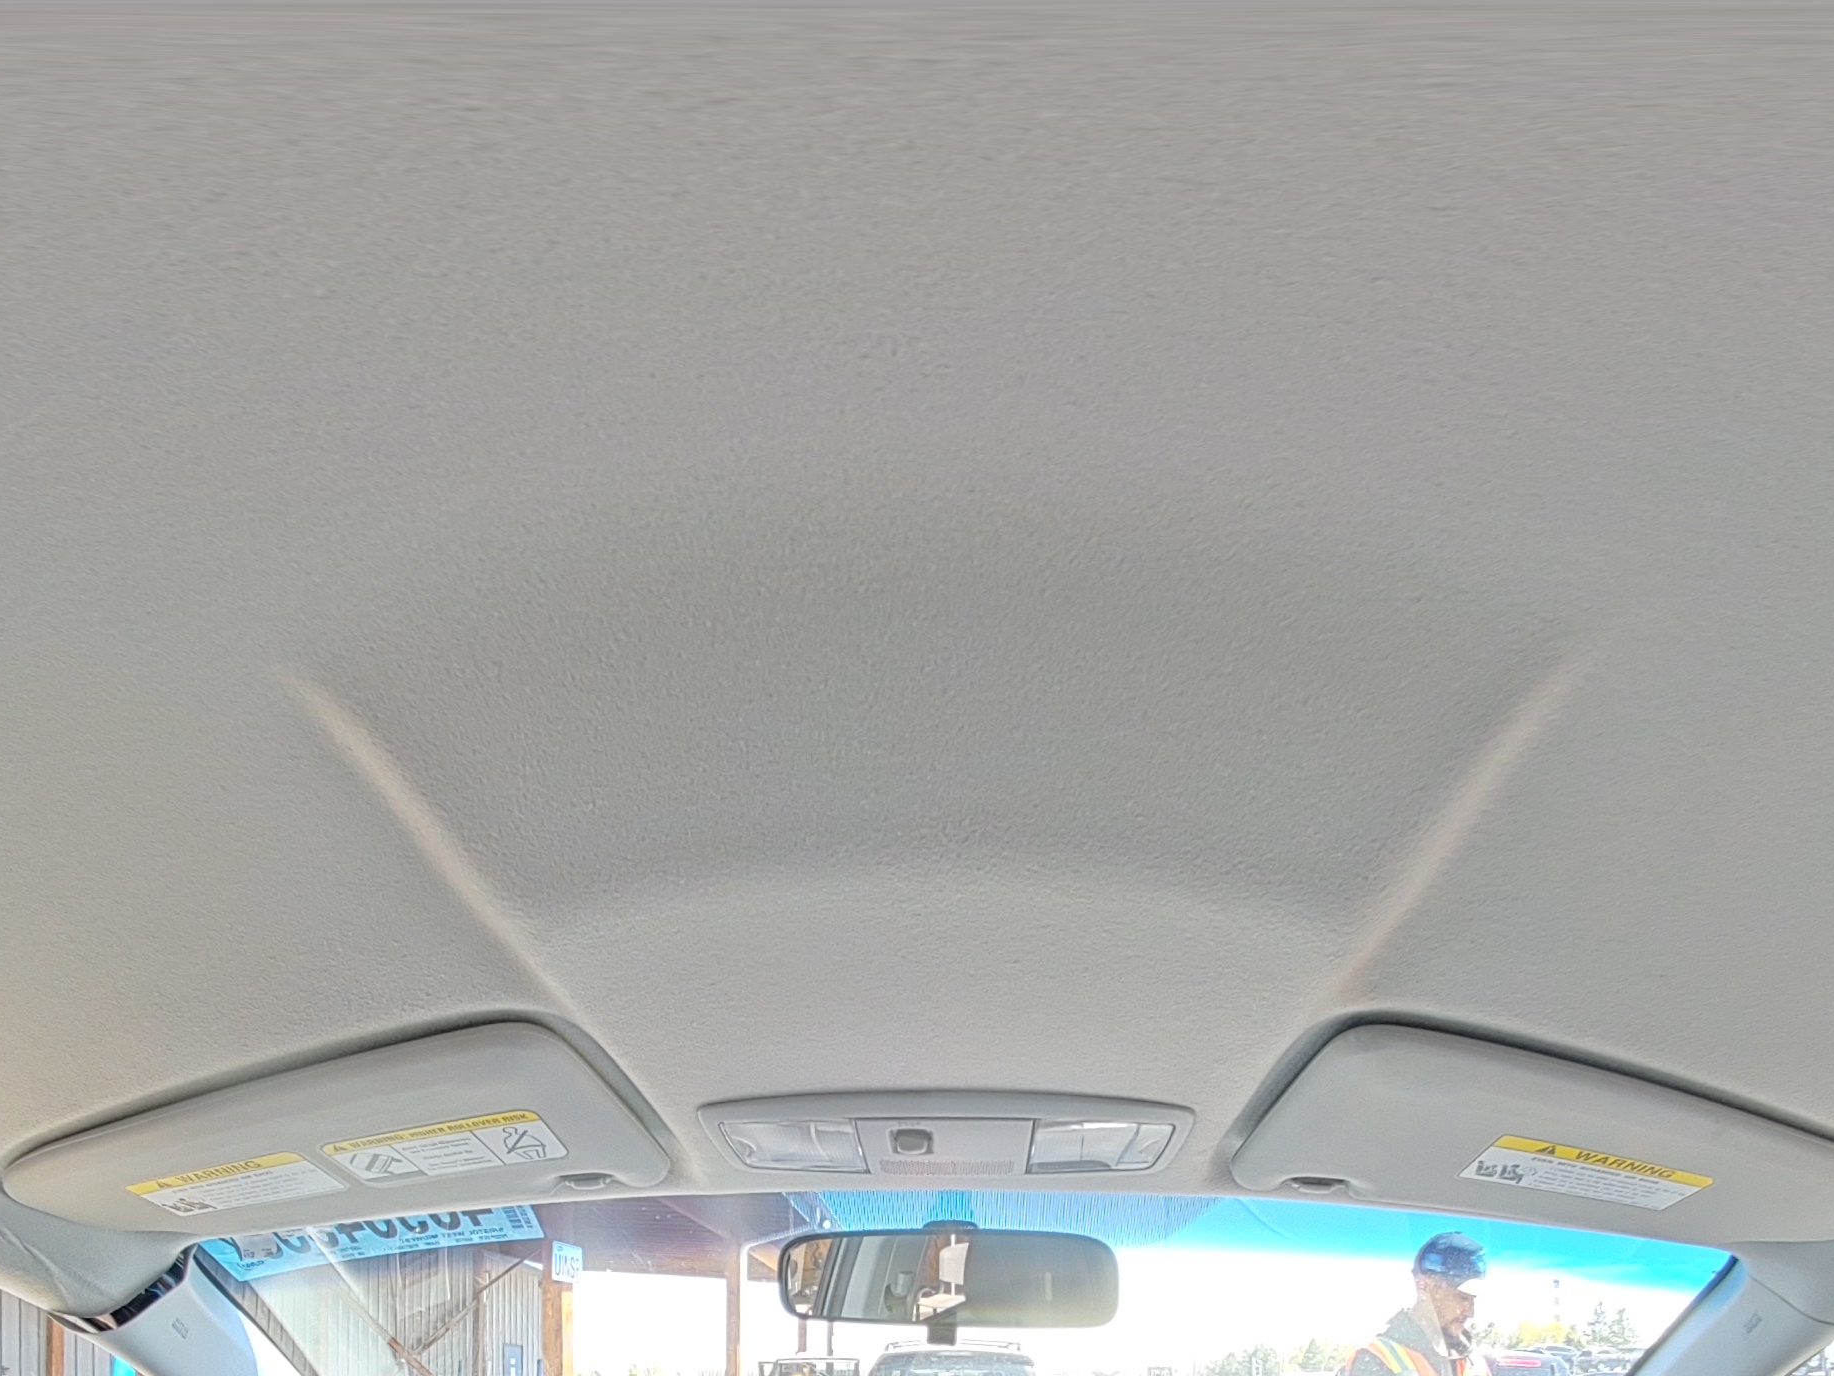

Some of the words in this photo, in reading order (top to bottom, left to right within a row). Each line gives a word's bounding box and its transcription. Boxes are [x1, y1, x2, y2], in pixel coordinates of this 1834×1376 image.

[503, 1112, 529, 1123] RISK
[176, 1160, 262, 1183] WARNING
[1575, 1150, 1677, 1179] WARNING
